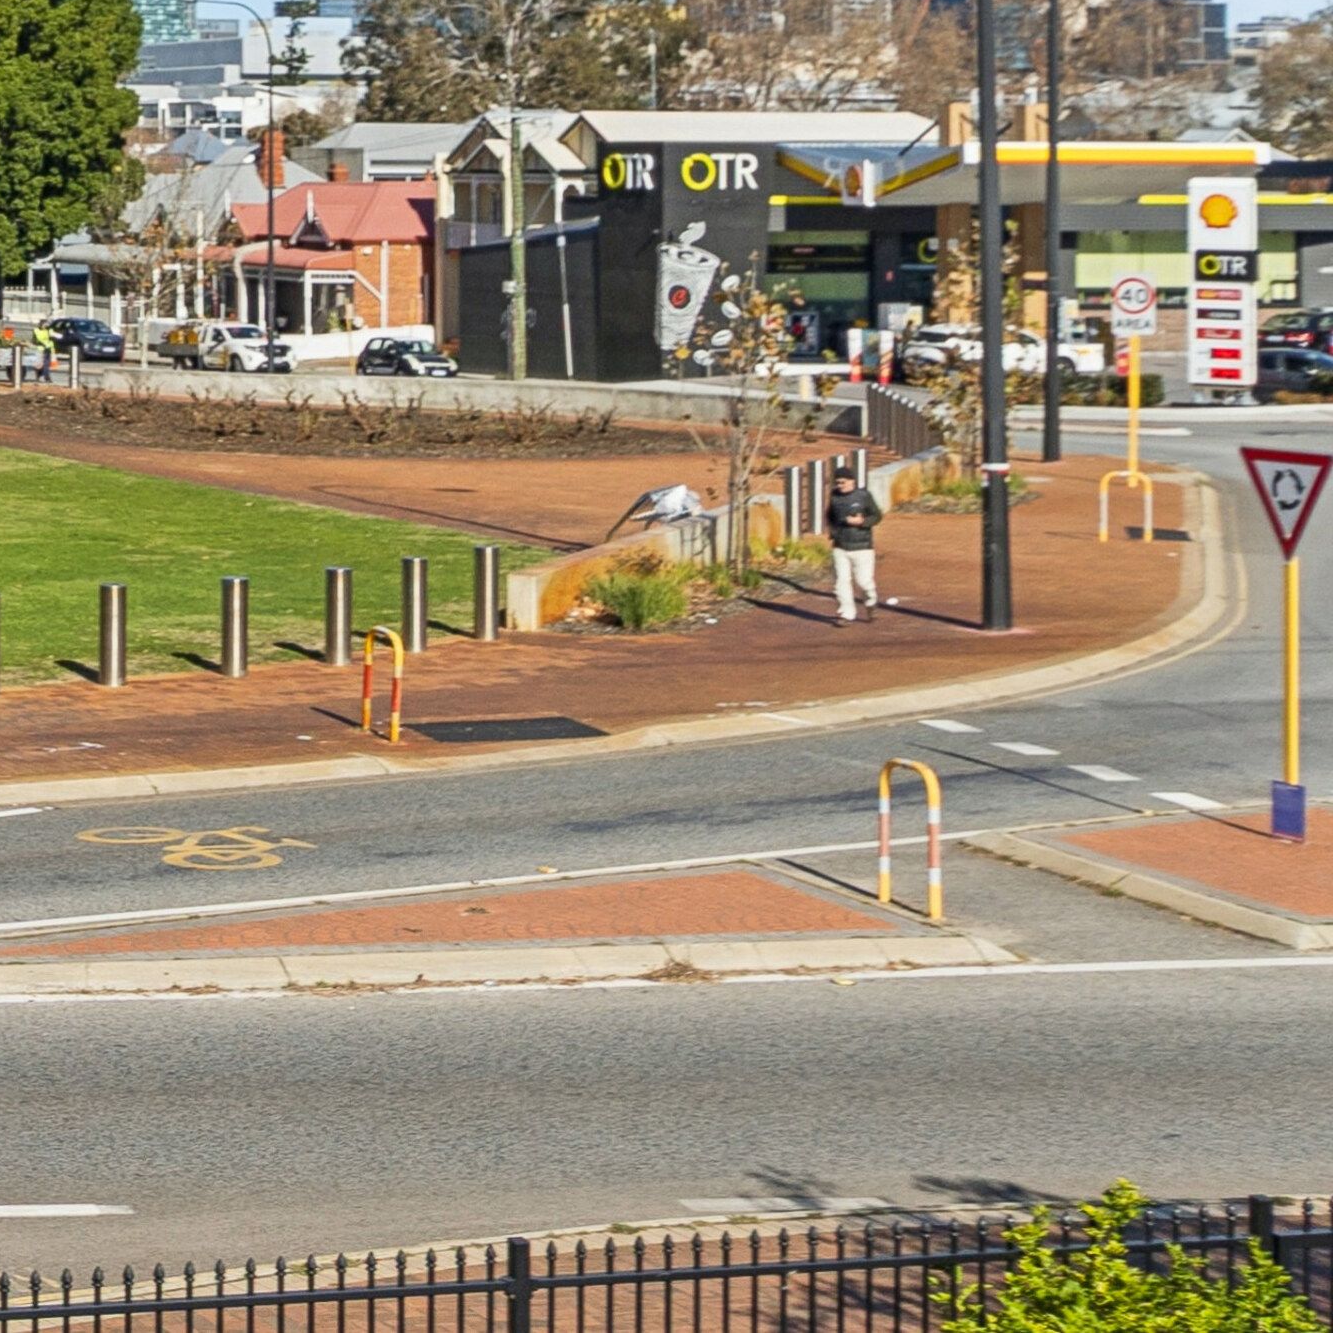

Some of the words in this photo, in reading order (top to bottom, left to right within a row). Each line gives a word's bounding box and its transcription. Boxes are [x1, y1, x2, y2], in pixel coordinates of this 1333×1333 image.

[602, 152, 654, 191] OTR
[681, 152, 758, 191] OTR
[1198, 254, 1247, 275] OTR
[1121, 288, 1147, 303] 40
